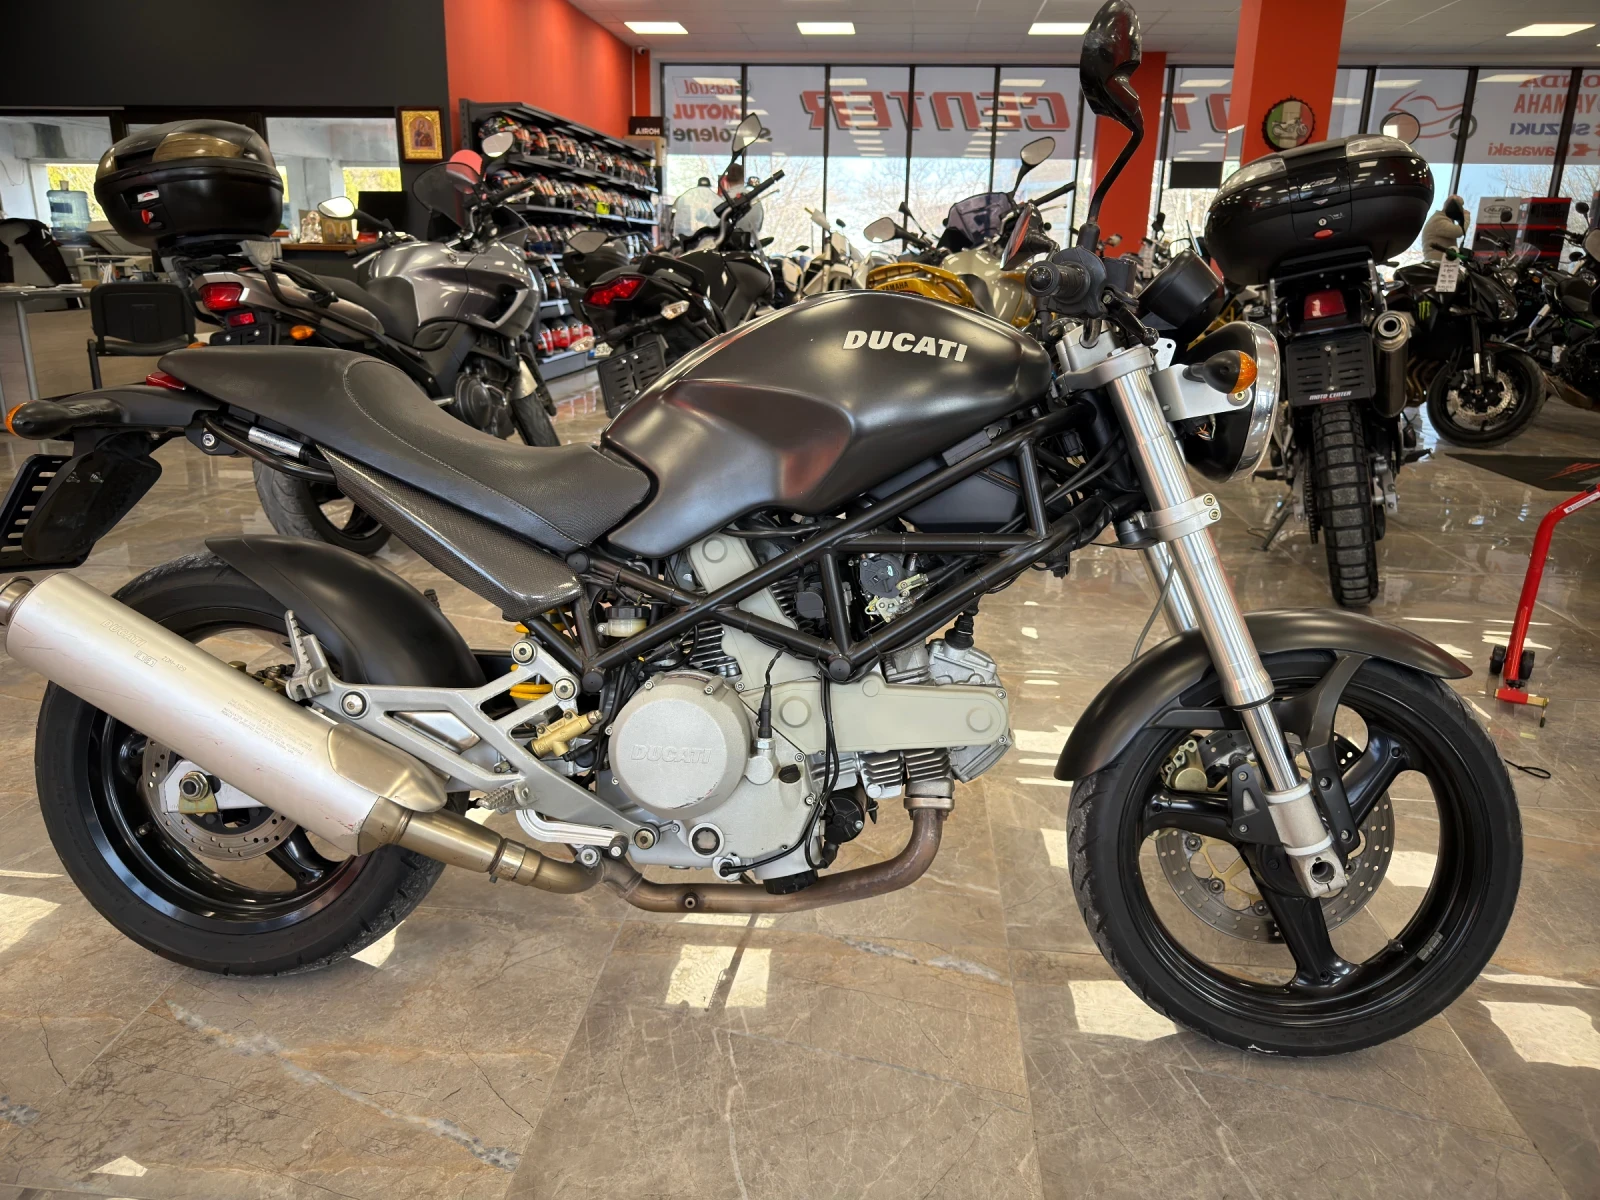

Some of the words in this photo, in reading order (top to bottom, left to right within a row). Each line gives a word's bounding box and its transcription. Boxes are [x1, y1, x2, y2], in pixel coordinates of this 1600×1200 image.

[842, 330, 968, 363] DUCATI
[100, 618, 148, 648] DUCATI
[630, 744, 713, 764] DUCATI
